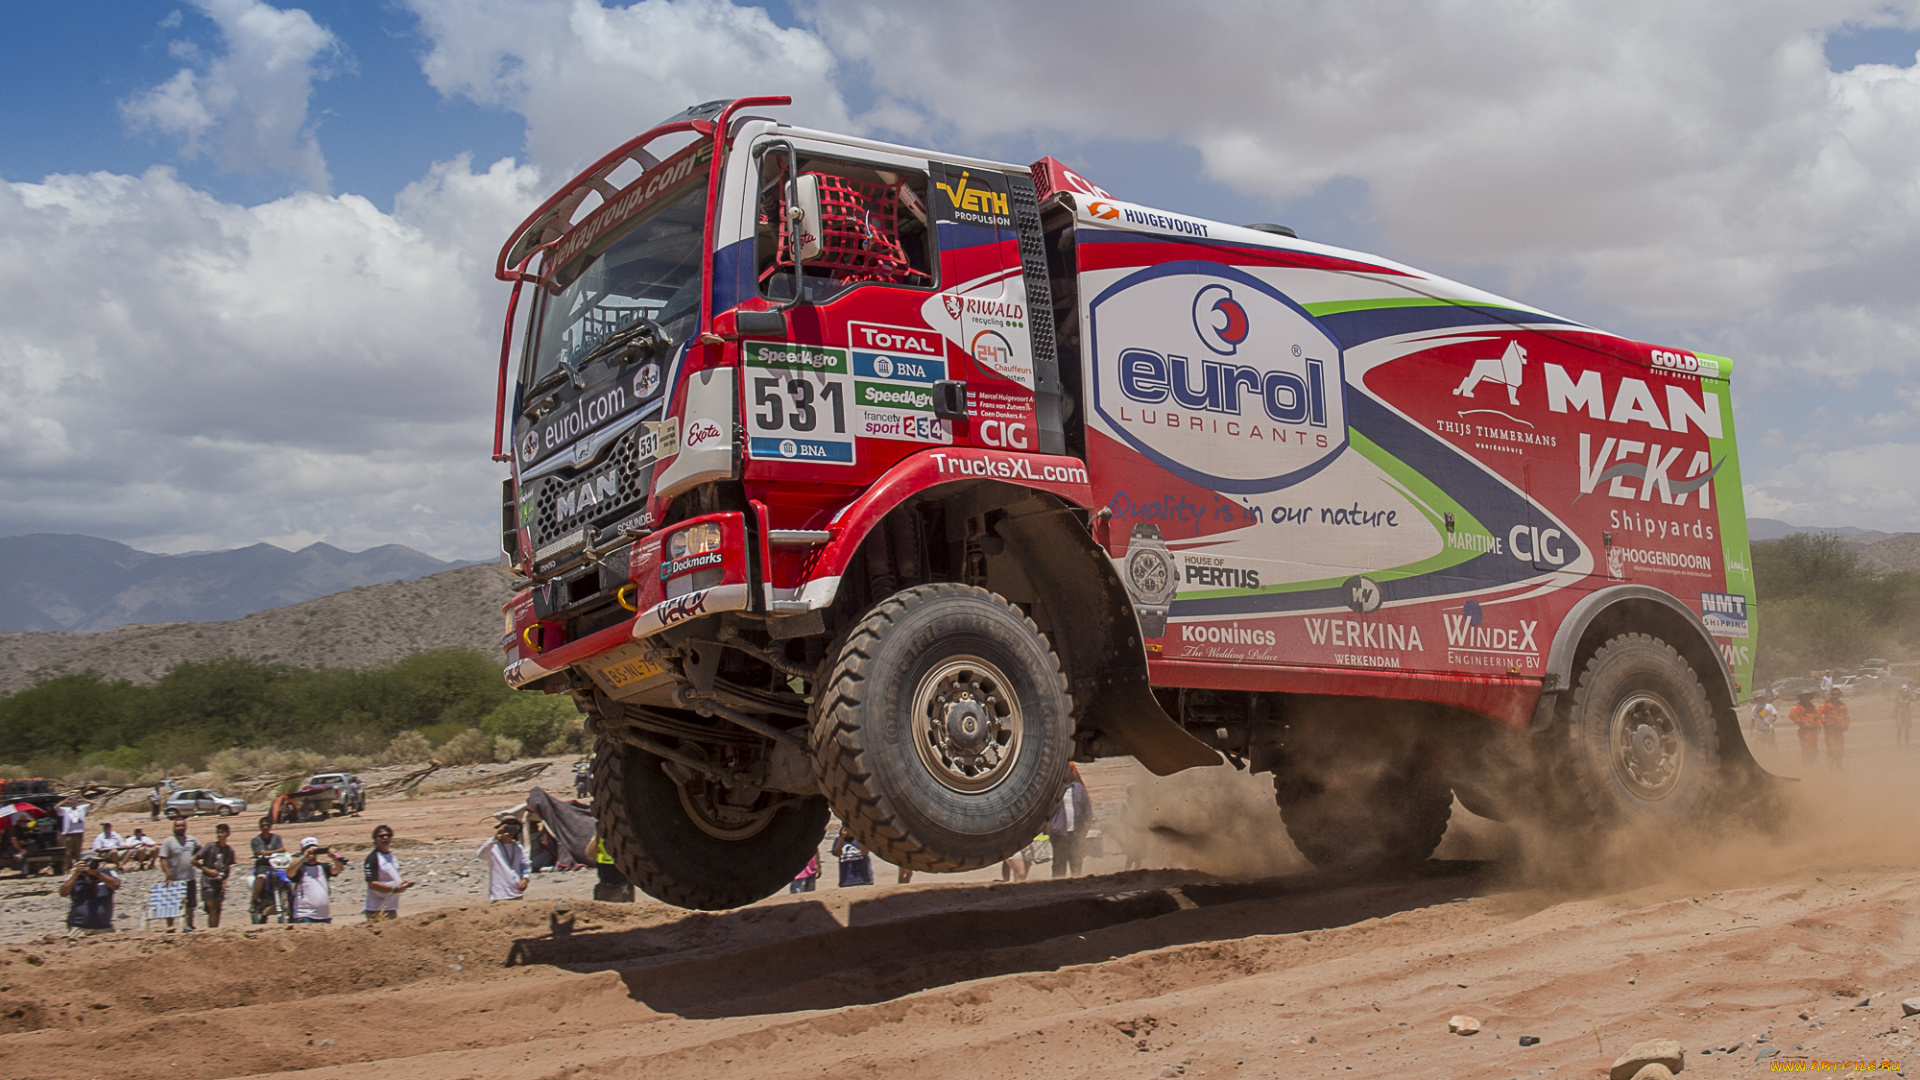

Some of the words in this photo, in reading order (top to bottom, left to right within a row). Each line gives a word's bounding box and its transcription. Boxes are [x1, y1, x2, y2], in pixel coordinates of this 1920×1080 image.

[936, 171, 1009, 215] VETH
[551, 151, 696, 272] vekagroup.com
[954, 211, 1011, 226] PROPULSION
[1124, 208, 1208, 237] HUIGEVOORT
[966, 299, 1023, 319] RIWALD
[972, 316, 1004, 328] recycling
[860, 327, 935, 352] TOTAL
[758, 347, 838, 368] SpeedAgro
[994, 363, 1032, 374] Chauffeurs
[897, 363, 926, 378] BNA
[1118, 347, 1328, 428] eurol
[754, 377, 846, 434] 531
[1543, 362, 1724, 440] MAN
[545, 387, 625, 449] eurol.com
[865, 421, 900, 435] sport
[1120, 407, 1328, 448] LUBRICANTS
[640, 433, 658, 457] 531
[688, 422, 721, 447] Exota
[980, 420, 1028, 449] CIG
[1437, 420, 1471, 436] THIJS
[1476, 425, 1556, 447] TIMMERMANS
[800, 444, 827, 457] BNA
[930, 453, 1088, 484] TrucksXL.com
[1579, 433, 1710, 510] VEKA
[556, 470, 617, 522] MAN
[1109, 490, 1205, 535] Quality
[1214, 495, 1233, 521] is
[1243, 497, 1264, 524] in
[1271, 506, 1313, 525] our
[1320, 502, 1399, 528] nature
[1610, 509, 1714, 540] Shipyards
[1447, 531, 1503, 555] MARITIME
[1509, 524, 1564, 565] CIG
[672, 552, 722, 574] Dockmarks
[1185, 556, 1212, 566] HOUSE
[1213, 558, 1225, 567] OF
[1622, 548, 1711, 571] HOOGENDOORN
[1185, 565, 1260, 590] PERTIJS
[657, 590, 707, 626] VEKA
[1304, 618, 1424, 652] WERKINA
[1704, 618, 1747, 629] SHIPPING
[1181, 644, 1203, 658] The
[1206, 646, 1245, 666] Wedding
[1248, 646, 1278, 661] Palace
[1334, 653, 1400, 668] WERKENDAM
[1448, 652, 1523, 668] ENGINEERING
[1526, 656, 1540, 669] BV
